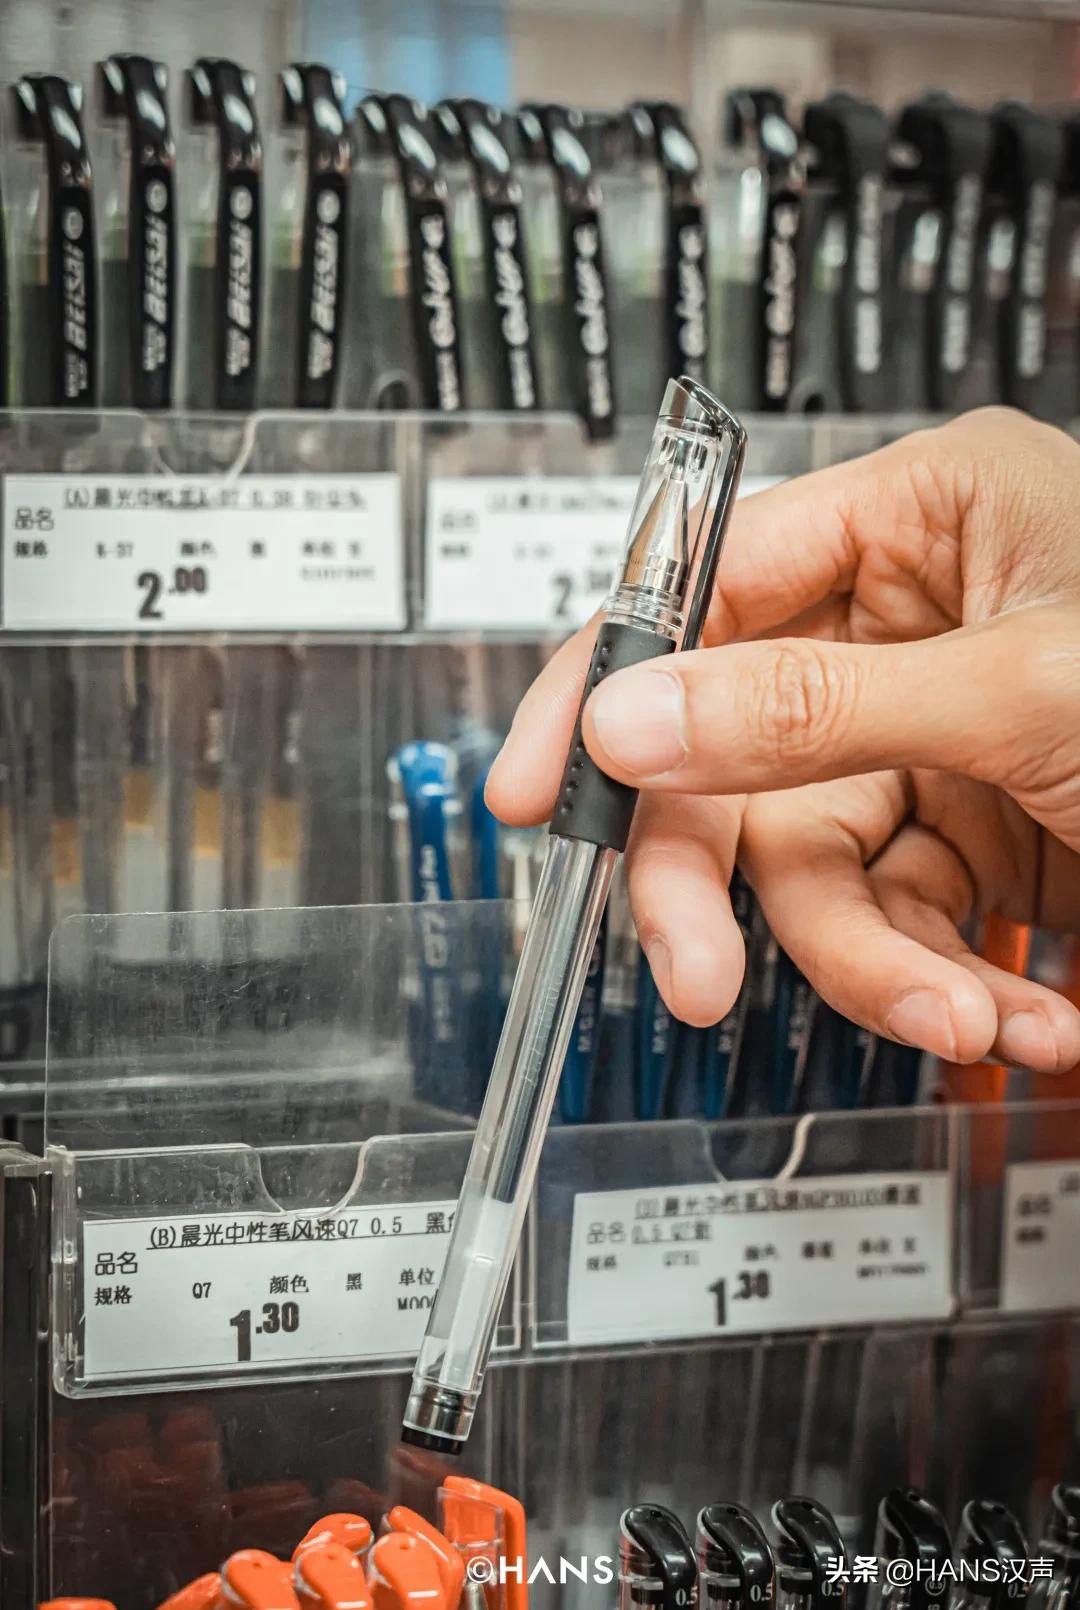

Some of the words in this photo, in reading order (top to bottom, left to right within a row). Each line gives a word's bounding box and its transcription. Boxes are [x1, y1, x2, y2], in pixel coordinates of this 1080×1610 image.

[14, 508, 54, 530] 品名
[137, 566, 208, 619] 2.00
[370, 1215, 402, 1235] 0.5
[587, 1222, 626, 1244] 品名
[95, 1251, 138, 1276] 品名
[269, 1275, 310, 1295] 颜色
[345, 1272, 363, 1291] 黑
[399, 1268, 435, 1287] 单位
[94, 1285, 132, 1306] 规格
[192, 1282, 211, 1299] Q7
[708, 1270, 770, 1326] 1.30
[229, 1301, 299, 1362] 1.30
[675, 1586, 698, 1606] 0.5
[750, 1583, 773, 1602] 0.5
